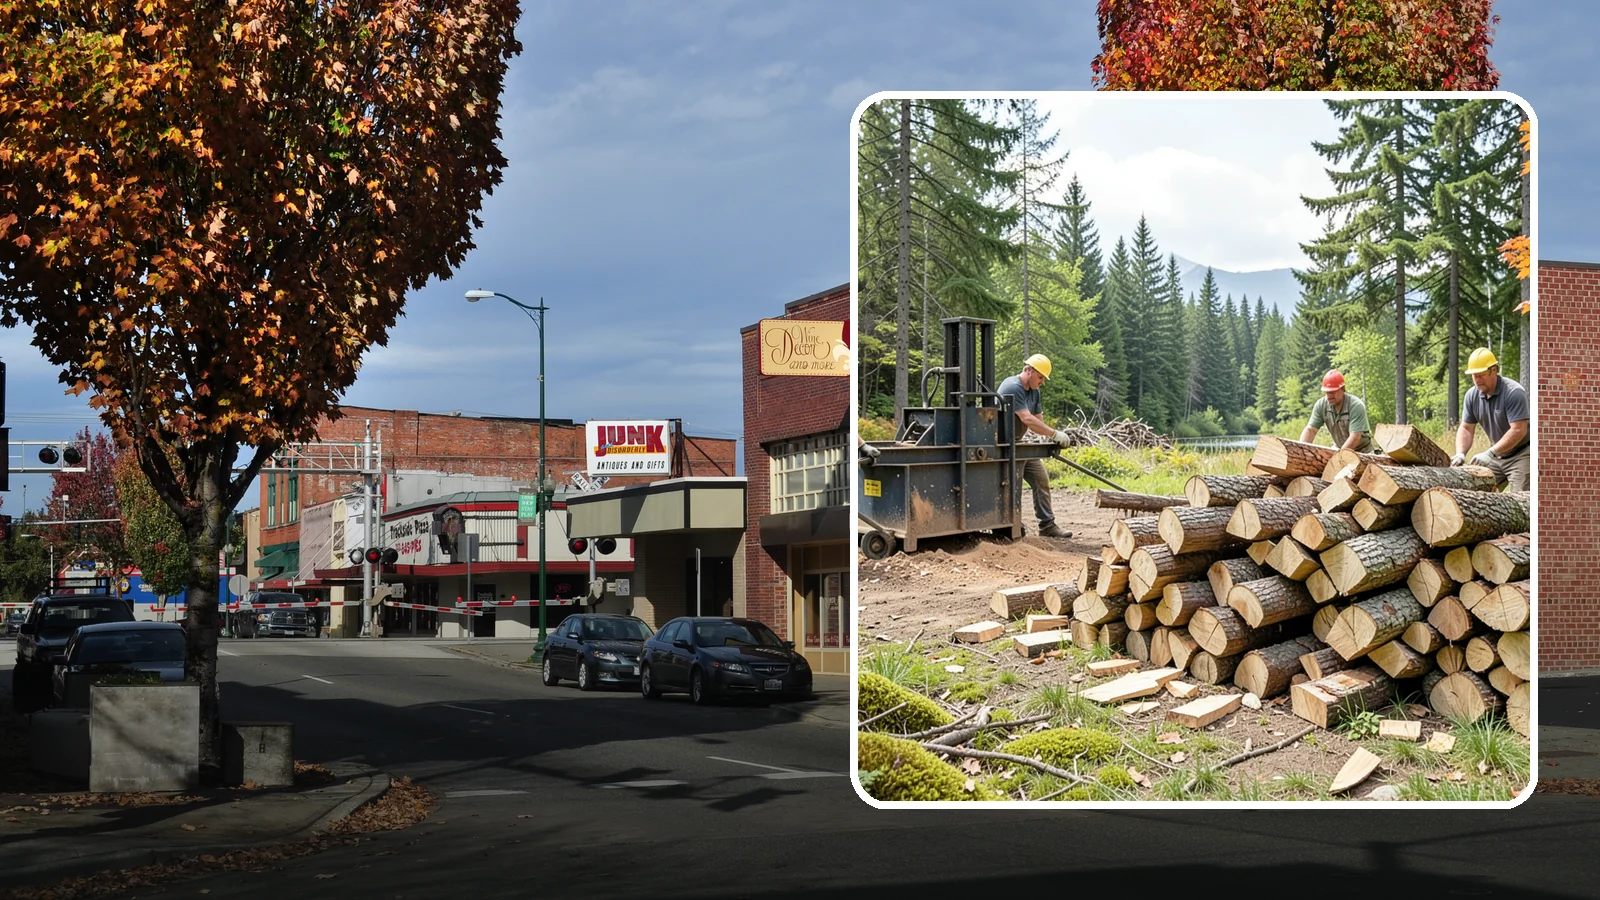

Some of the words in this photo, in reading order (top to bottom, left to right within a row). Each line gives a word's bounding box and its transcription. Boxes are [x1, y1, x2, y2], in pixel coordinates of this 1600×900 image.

[595, 425, 665, 457] JUNK
[607, 446, 646, 454] DISORDERLY
[597, 461, 627, 470] ANTIQUES
[631, 461, 644, 470] AND
[647, 460, 665, 470] GIFTS
[415, 519, 429, 535] Pizza
